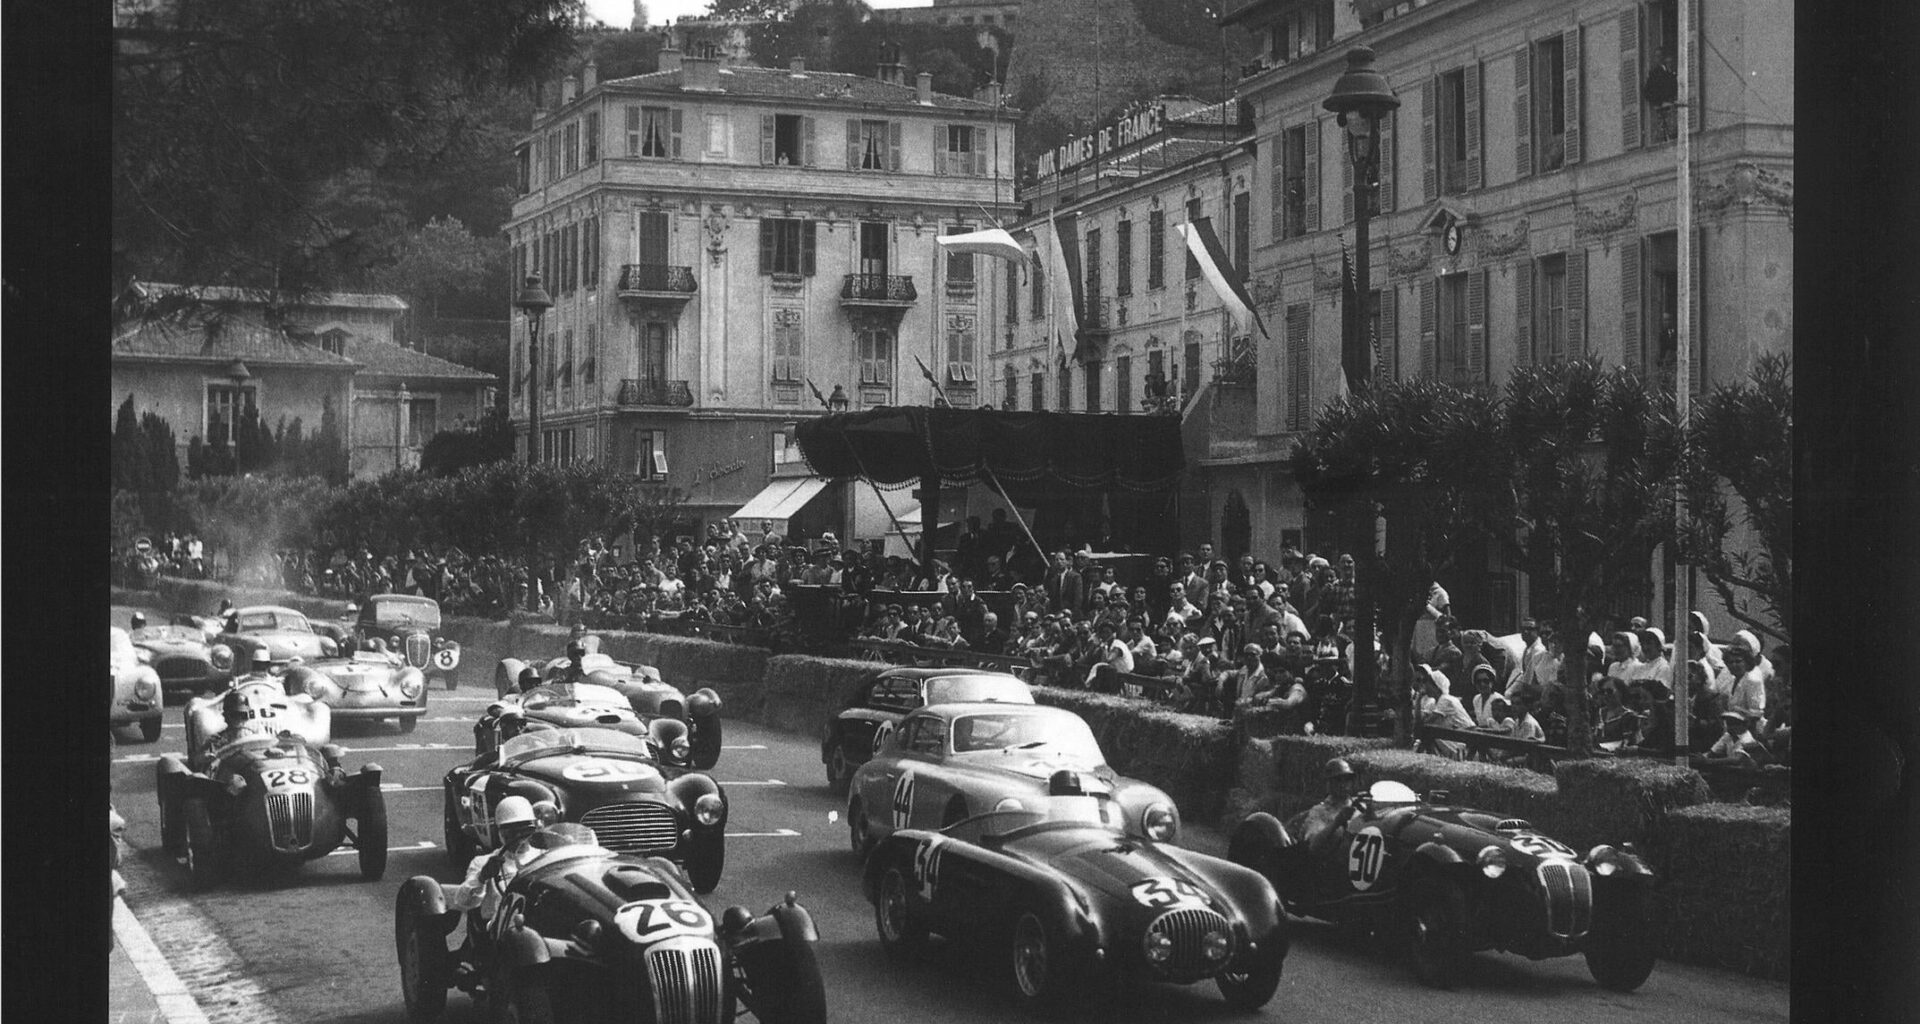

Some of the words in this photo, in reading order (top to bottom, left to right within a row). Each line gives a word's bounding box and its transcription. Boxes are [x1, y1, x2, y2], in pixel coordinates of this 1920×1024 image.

[1037, 149, 1056, 179] AUX
[1099, 127, 1112, 154] DE
[1118, 106, 1162, 147] FRANCE
[441, 651, 453, 666] 8
[268, 770, 309, 787] 28
[894, 777, 913, 829] 44
[1350, 834, 1381, 883] 30
[1513, 837, 1574, 855] 30
[1127, 878, 1210, 906] 34
[620, 902, 706, 936] 26
